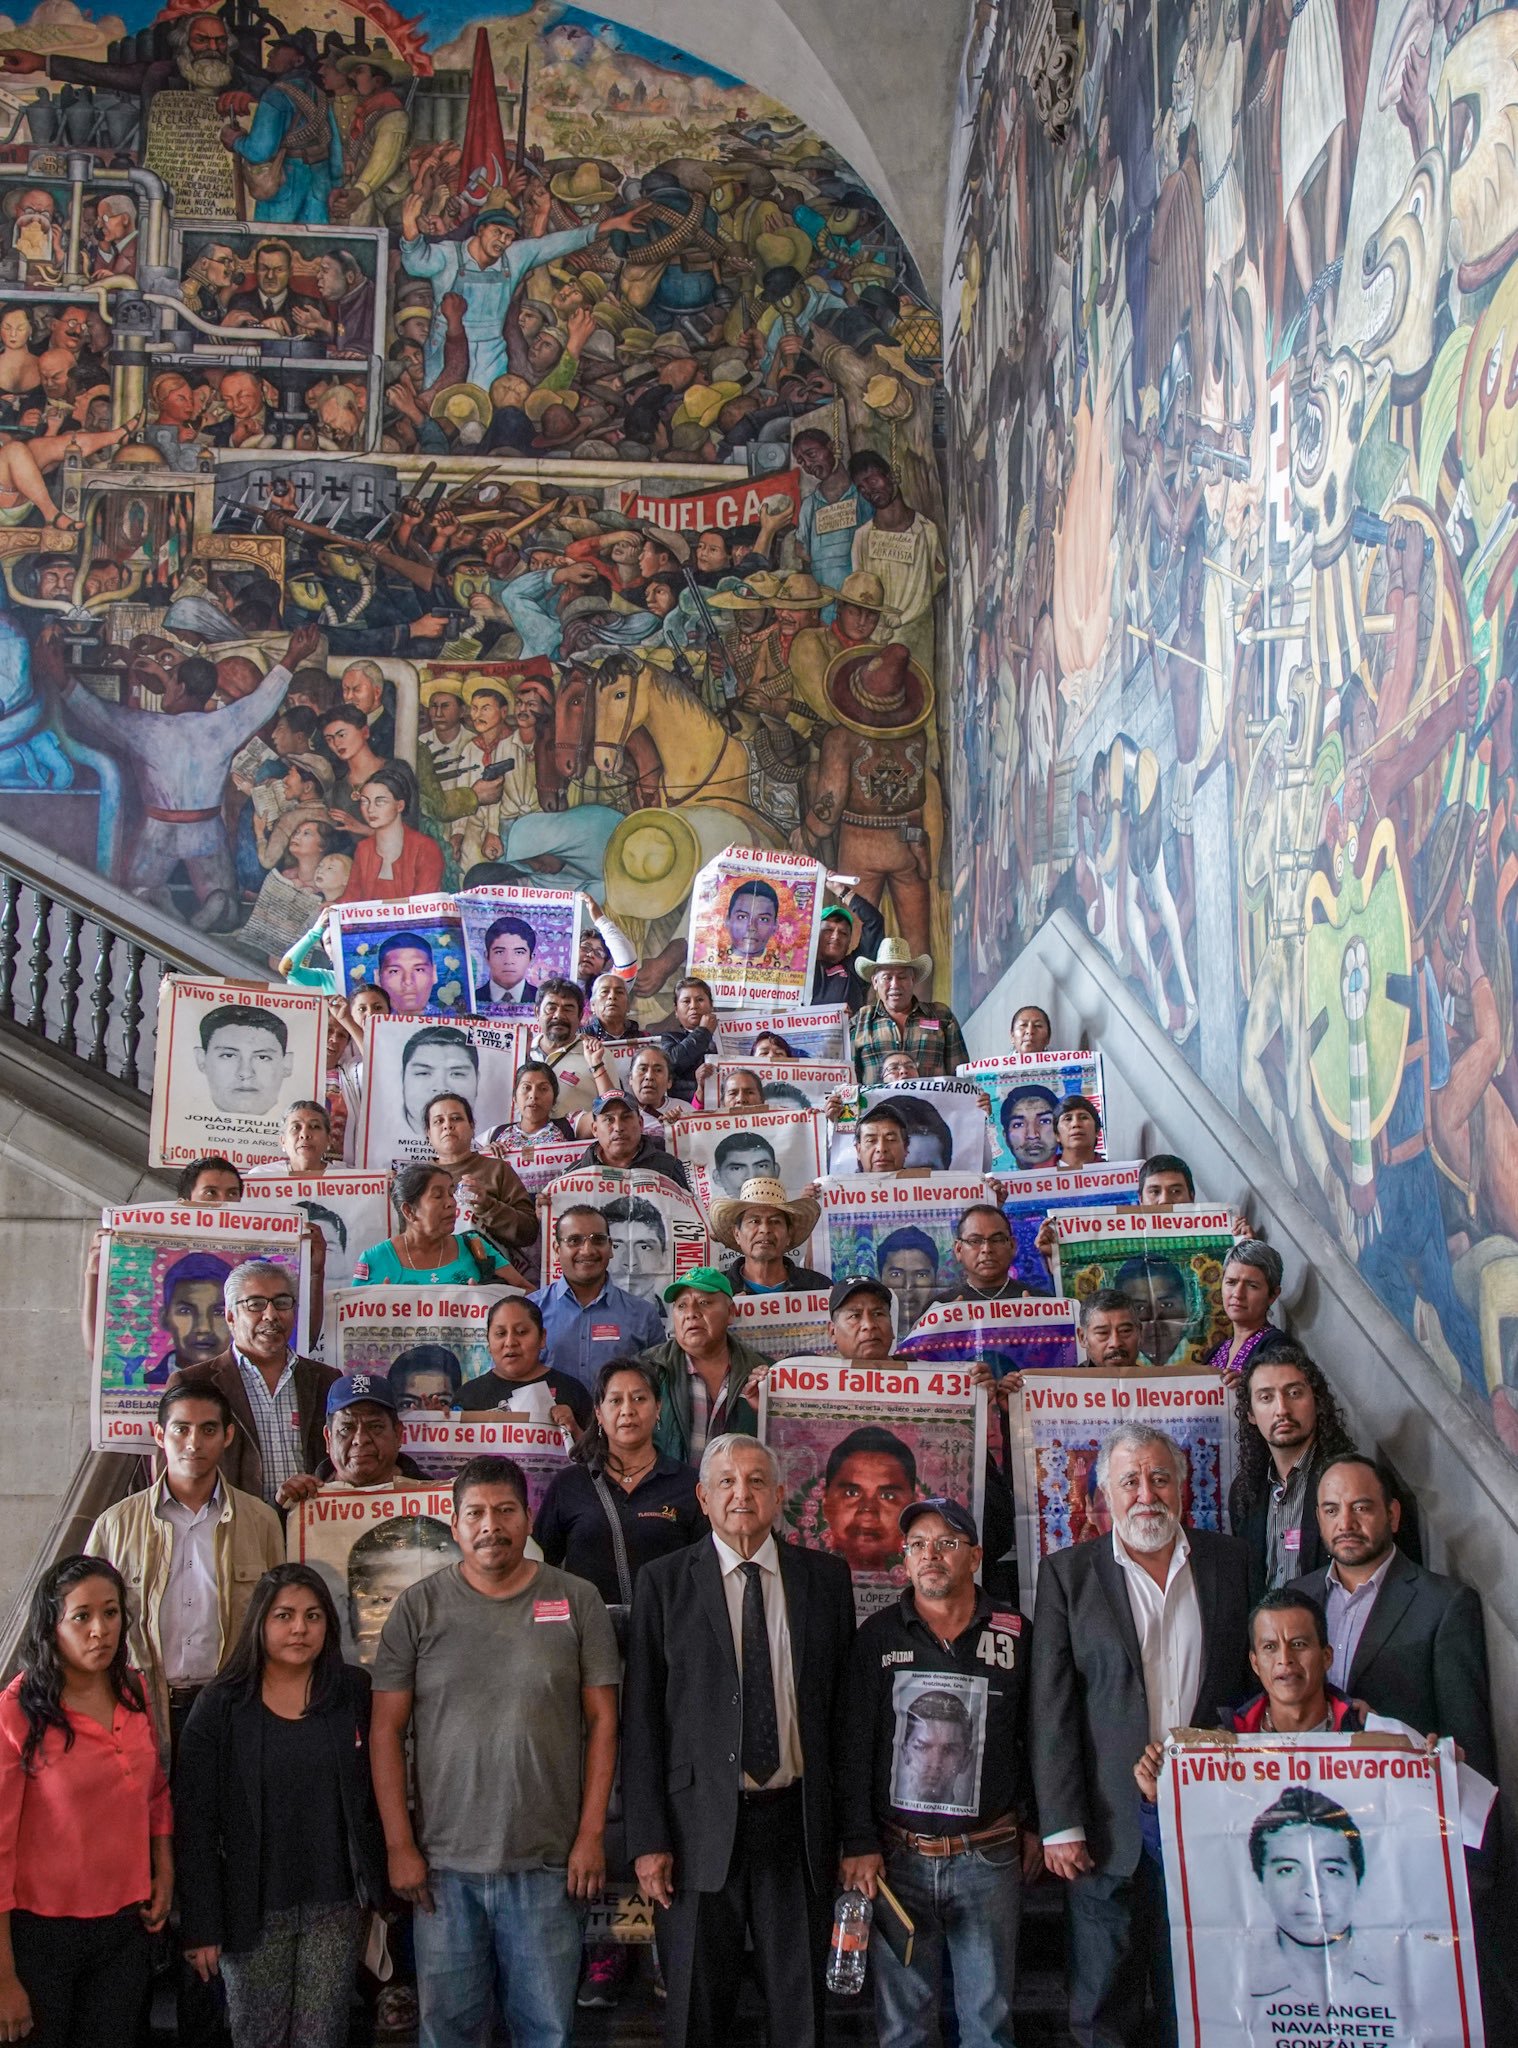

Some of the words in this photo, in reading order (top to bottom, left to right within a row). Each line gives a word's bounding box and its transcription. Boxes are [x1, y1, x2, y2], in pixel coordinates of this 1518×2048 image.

[637, 489, 761, 532] HUELGA
[735, 848, 749, 860] se
[752, 850, 763, 861] lo
[766, 852, 817, 868] llevaron!
[491, 887, 504, 897] se
[507, 886, 519, 898] lo
[522, 887, 573, 900] llevaron!
[341, 906, 373, 921] ¡Vivo
[376, 907, 391, 917] se
[393, 905, 405, 917] lo
[408, 902, 459, 915] llevaron!
[178, 986, 215, 1002] ¡Vivo
[219, 993, 235, 1003] se
[239, 992, 251, 1005] lo
[256, 994, 317, 1011] llevaron!
[715, 985, 736, 997] VIDA
[750, 988, 800, 1001] queremos!
[418, 1016, 432, 1024] se
[437, 1015, 450, 1025] lo
[720, 1019, 752, 1034] ¡Vivo
[756, 1021, 769, 1031] se
[773, 1017, 784, 1029] lo
[788, 1013, 841, 1027] llevaron!
[477, 1029, 501, 1040] TOÑO
[482, 1038, 502, 1048] VIVE
[1003, 1055, 1016, 1066] se
[1020, 1053, 1032, 1065] lo
[1036, 1051, 1092, 1064] llevaron!
[760, 1070, 772, 1080] se
[777, 1069, 789, 1081] lo
[184, 1112, 232, 1124] JONÁS
[236, 1118, 281, 1128] TRUJIL
[677, 1120, 712, 1137] ¡Vivo
[716, 1119, 730, 1131] se
[735, 1117, 748, 1128] lo
[752, 1111, 812, 1127] llevaron!
[252, 1138, 278, 1148] AÑOS
[170, 1146, 196, 1160] ¡Con
[232, 1151, 242, 1163] lo
[247, 1154, 289, 1166] quere
[536, 1153, 585, 1166] llevar
[276, 1185, 293, 1198] se
[298, 1182, 312, 1197] lo
[317, 1181, 385, 1197] llevaron!
[553, 1178, 594, 1194] ¡Vivo
[598, 1182, 614, 1193] se
[620, 1180, 631, 1195] lo
[1003, 1181, 1032, 1196] Vivo
[1036, 1180, 1052, 1192] se
[1057, 1177, 1070, 1191] lo
[1075, 1170, 1139, 1189] llevaron!
[824, 1189, 866, 1208] ¡Vivo
[871, 1191, 888, 1204] se
[894, 1187, 908, 1202] lo
[913, 1184, 984, 1202] llevaron!
[115, 1210, 165, 1226] ¡Vivo
[170, 1211, 191, 1226] se
[197, 1210, 213, 1227] lo
[219, 1212, 299, 1233] llevaron!
[673, 1220, 705, 1241] 43!
[1057, 1218, 1101, 1238] ¡Vivo
[1107, 1218, 1126, 1232] se
[1131, 1216, 1147, 1230] lo
[1152, 1213, 1229, 1230] llevaron!
[339, 1302, 388, 1322] ¡Vivo
[392, 1302, 411, 1317] se
[417, 1300, 433, 1317] lo
[439, 1300, 490, 1319] llevar
[760, 1299, 780, 1315] se
[785, 1297, 801, 1314] lo
[944, 1308, 963, 1323] se
[969, 1303, 984, 1321] lo
[991, 1300, 1070, 1319] llevaron!
[770, 1367, 829, 1393] ¡Nos
[838, 1369, 919, 1395] faltan
[927, 1373, 971, 1397] 43!
[118, 1400, 160, 1409] ABELAR
[1025, 1388, 1078, 1411] ¡Vivo
[1084, 1392, 1106, 1408] se
[1112, 1388, 1130, 1408] lo
[1136, 1387, 1224, 1408] llevaron!
[108, 1420, 143, 1438] ¡Con
[402, 1424, 450, 1445] ¡Vivo
[455, 1428, 475, 1443] se
[480, 1426, 496, 1444] lo
[502, 1425, 564, 1447] llevaro
[308, 1500, 366, 1526] ¡Vivo
[371, 1499, 395, 1519] se
[401, 1495, 422, 1518] lo
[860, 1592, 890, 1603] LÓPEZ
[976, 1630, 1016, 1670] 43
[1182, 1757, 1246, 1785] ¡Vivo
[1253, 1760, 1281, 1781] se
[1289, 1756, 1311, 1781] lo
[1319, 1757, 1430, 1781] llevaron!
[1266, 2002, 1320, 2017] JOSÉ
[1271, 2021, 1395, 2038] NAVARRETE
